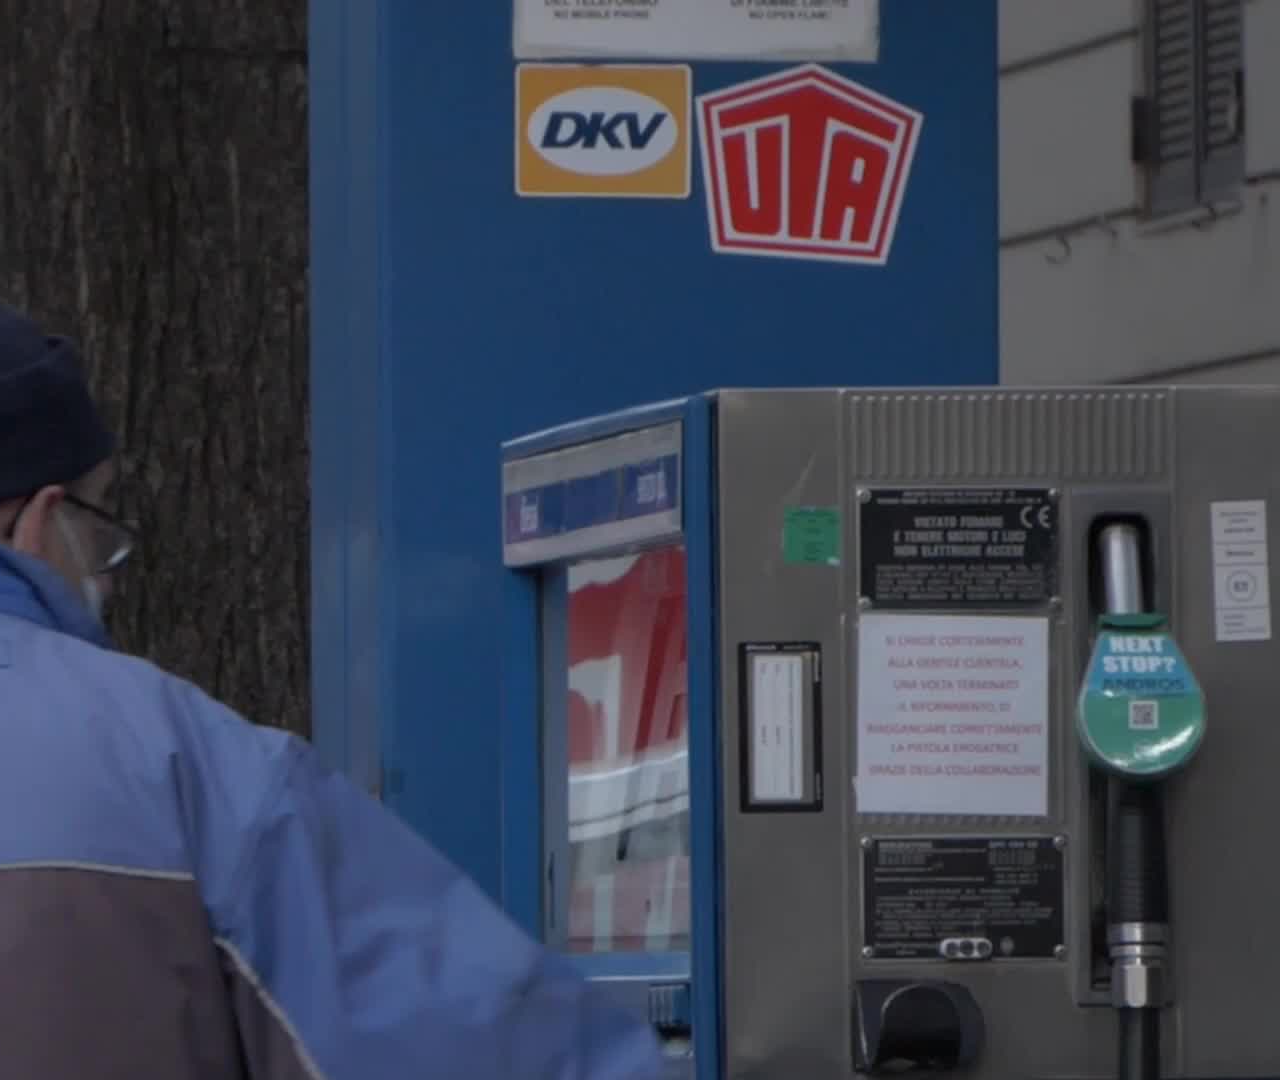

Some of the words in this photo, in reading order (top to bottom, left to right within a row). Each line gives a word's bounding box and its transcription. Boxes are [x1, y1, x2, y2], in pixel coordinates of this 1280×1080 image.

[541, 111, 668, 150] DKV
[717, 82, 902, 245] UTA
[1109, 635, 1164, 653] NEXT
[1103, 656, 1177, 673] STOP?
